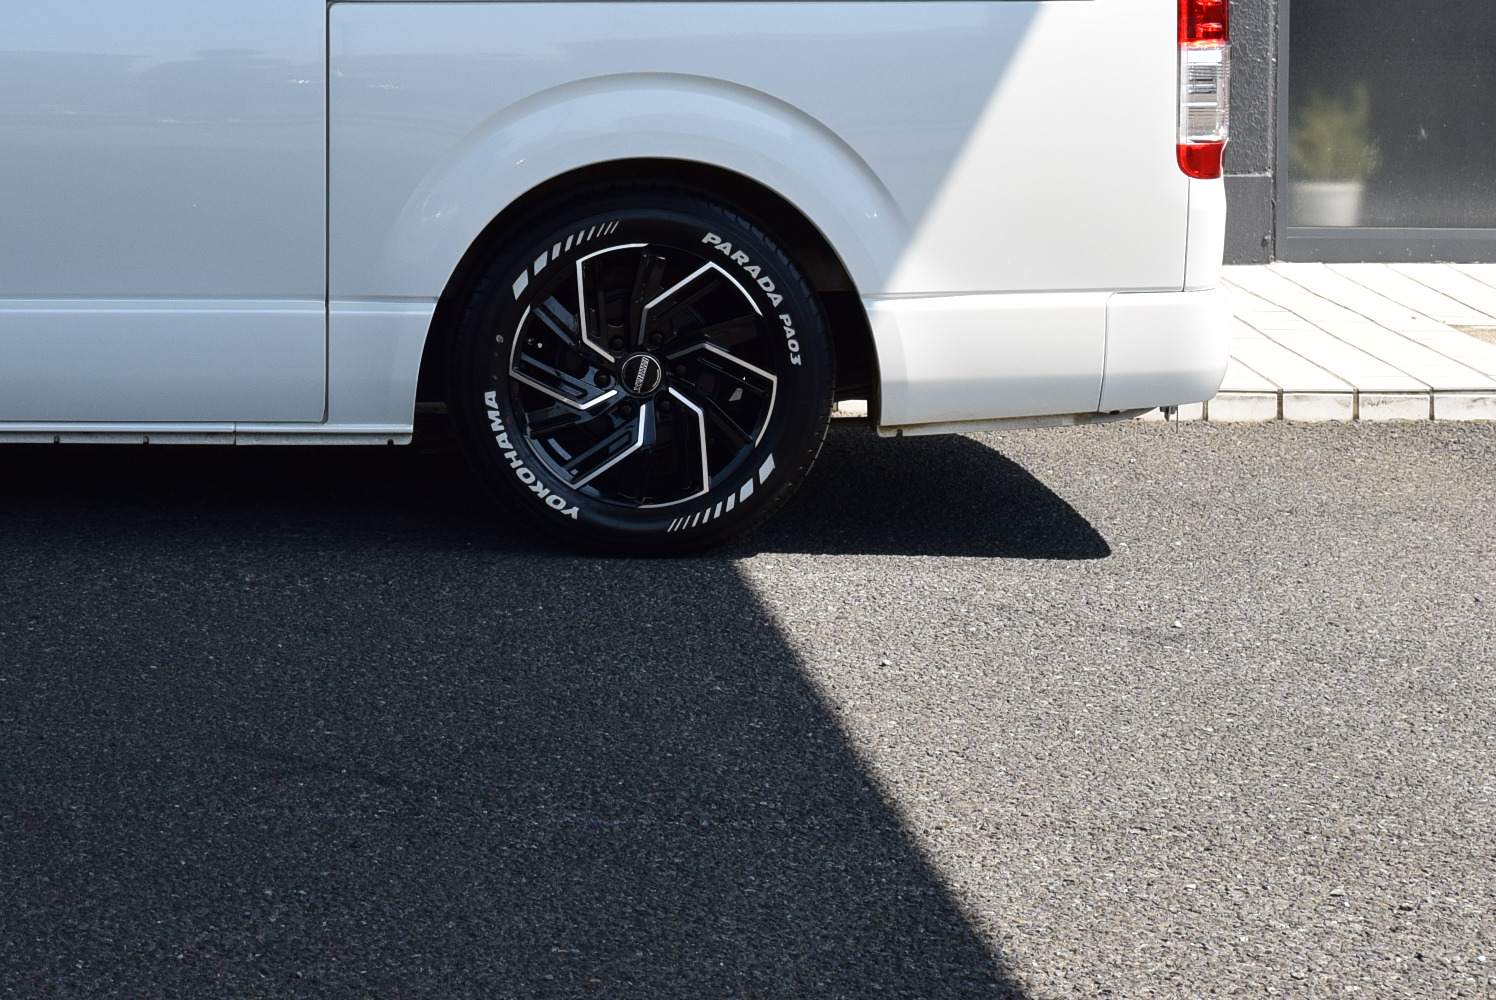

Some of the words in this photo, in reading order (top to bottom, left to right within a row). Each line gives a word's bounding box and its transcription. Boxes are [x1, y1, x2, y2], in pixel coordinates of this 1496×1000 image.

[701, 231, 785, 309] PARADA
[778, 312, 803, 367] PA03
[484, 389, 581, 521] YOKOHAMA
